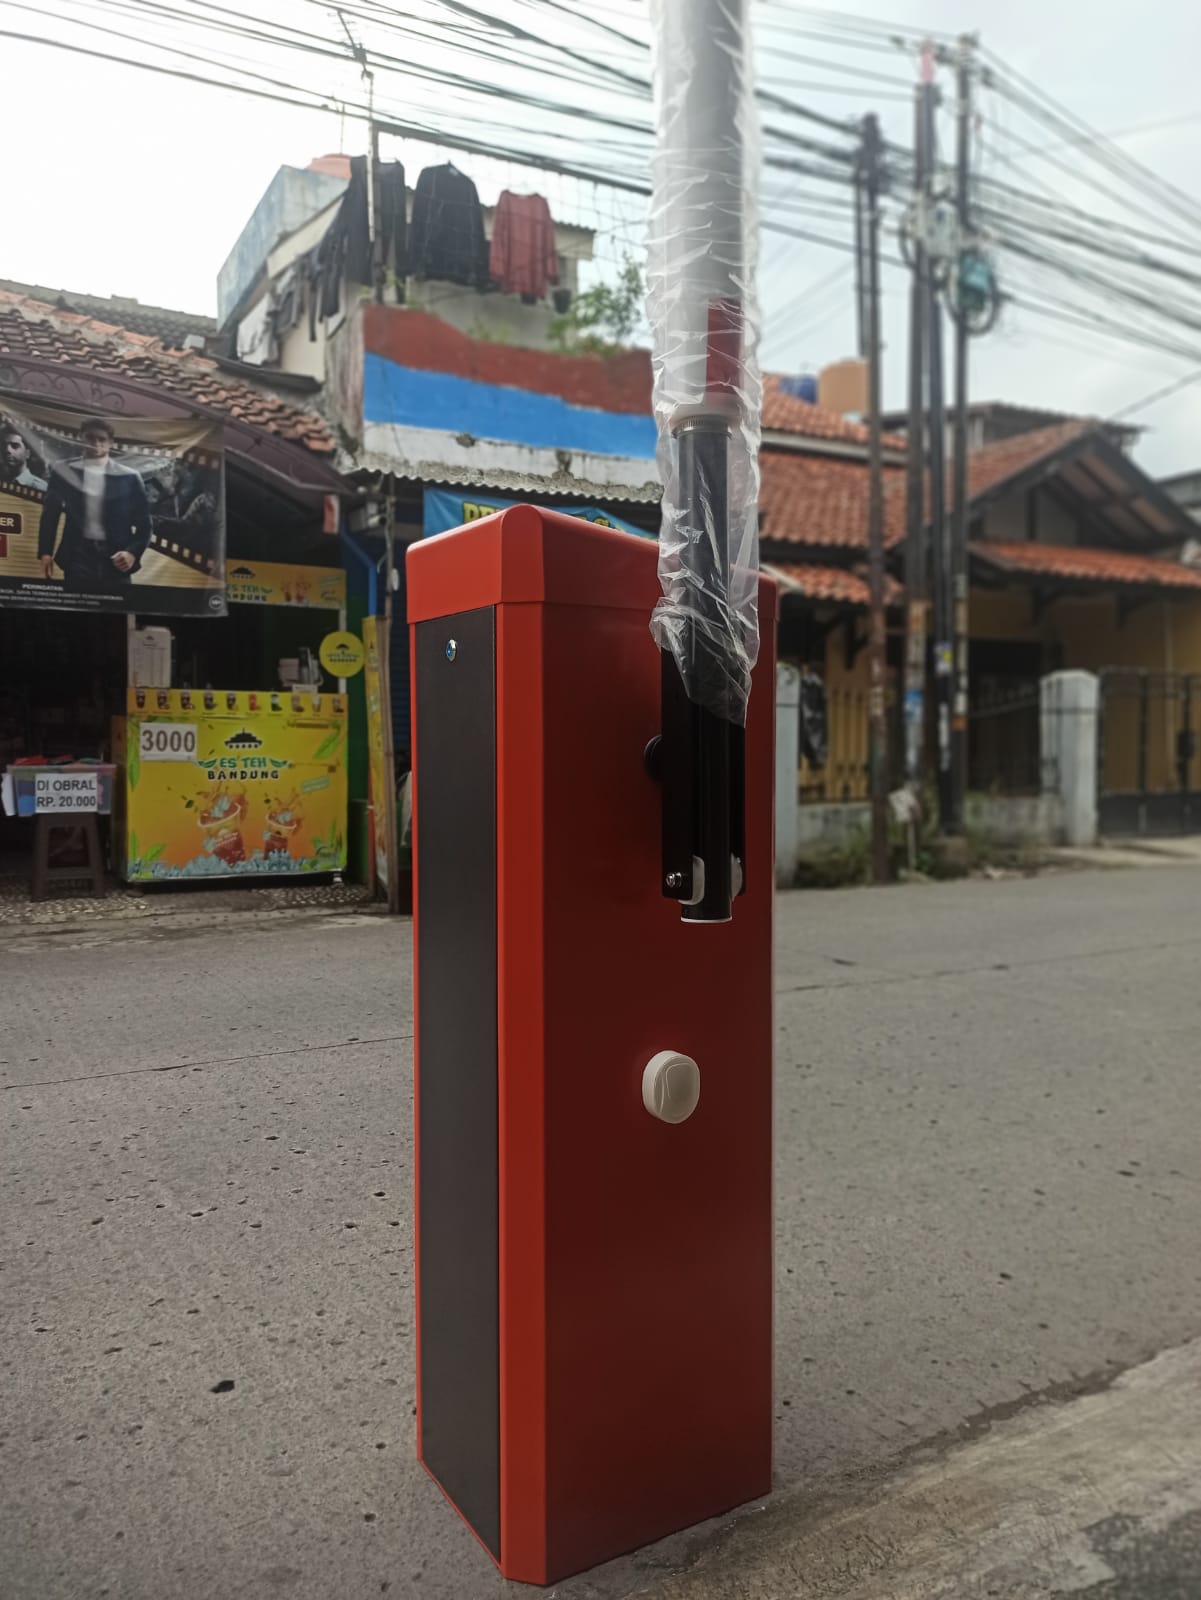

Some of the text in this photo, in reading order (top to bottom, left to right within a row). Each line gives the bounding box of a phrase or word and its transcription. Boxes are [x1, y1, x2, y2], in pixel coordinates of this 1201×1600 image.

[141, 730, 196, 753] 3000
[220, 757, 267, 768] ES TEH
[207, 770, 279, 780] BANDUNG
[37, 780, 96, 791] DI OBRAL
[37, 796, 96, 807] RP. 20.000
